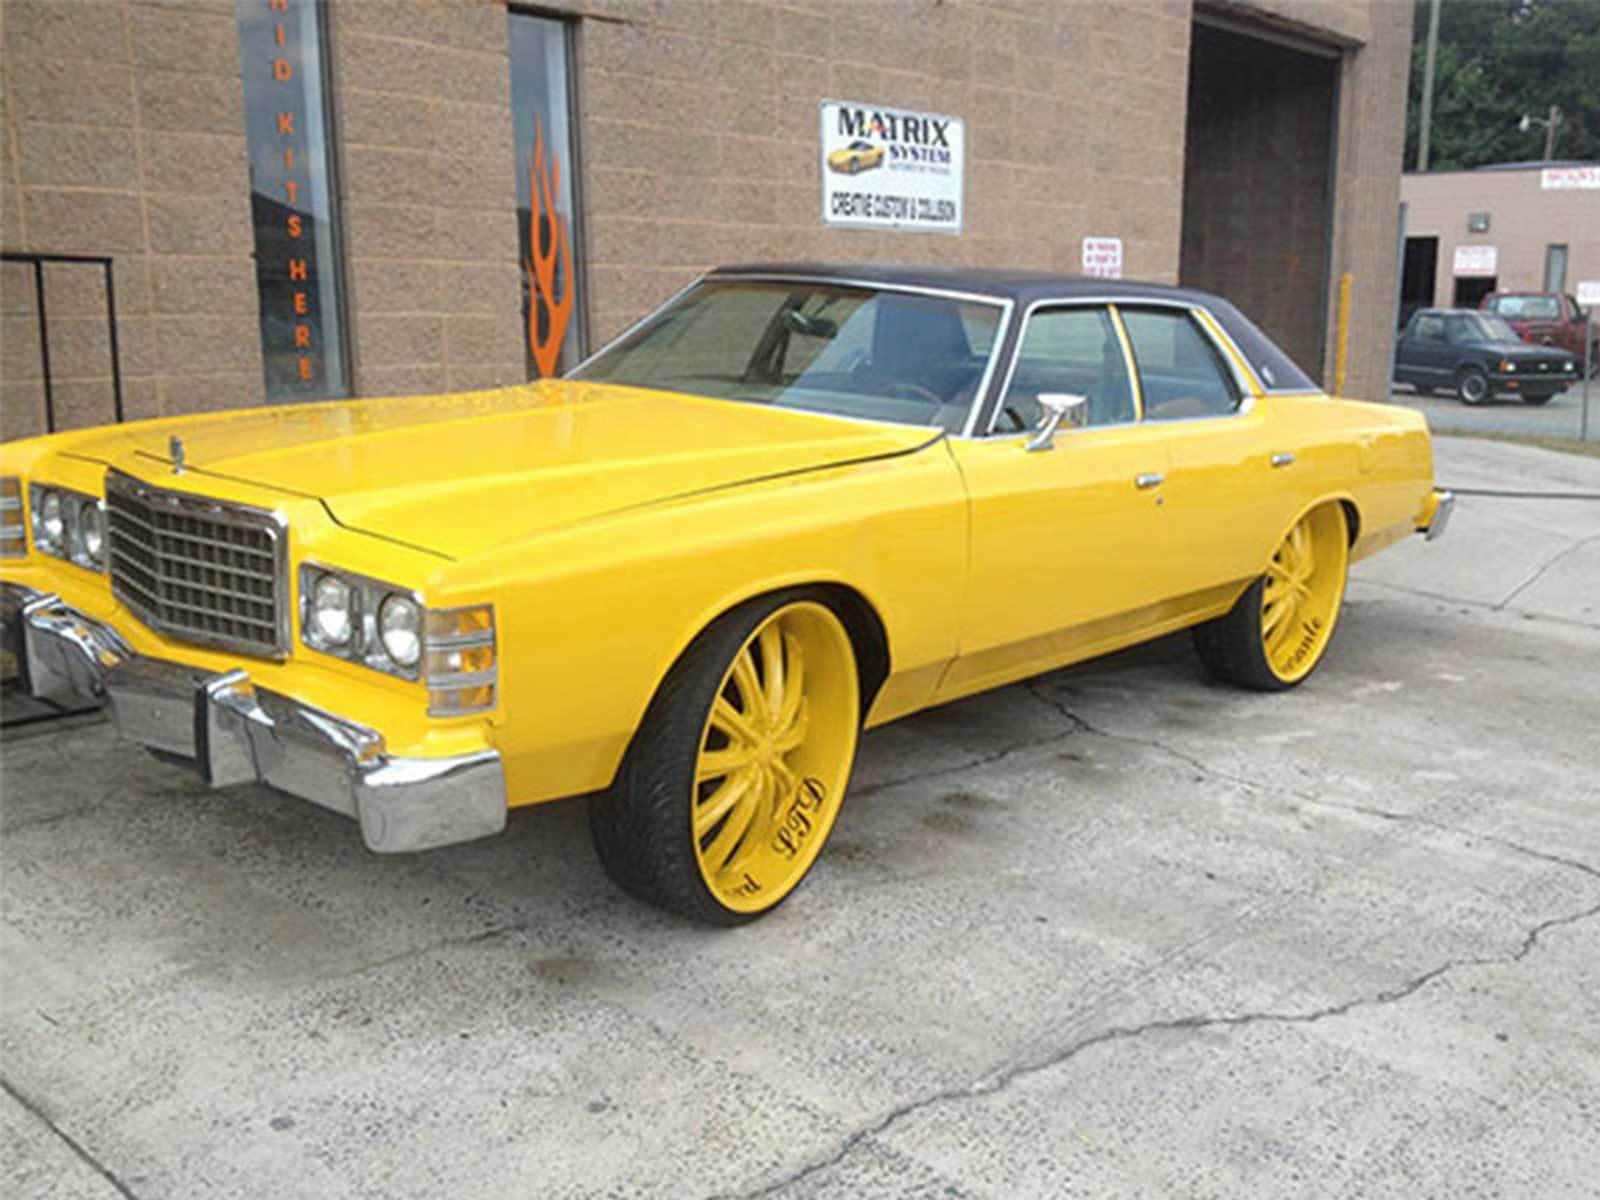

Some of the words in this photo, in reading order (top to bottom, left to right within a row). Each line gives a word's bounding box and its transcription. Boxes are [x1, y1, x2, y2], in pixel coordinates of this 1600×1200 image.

[838, 107, 949, 147] MATRIX
[889, 144, 951, 164] SYSTEM
[278, 113, 302, 238] KITS
[831, 191, 873, 217] CREATIVE
[918, 198, 956, 222] COLLISION
[289, 259, 313, 380] HERE
